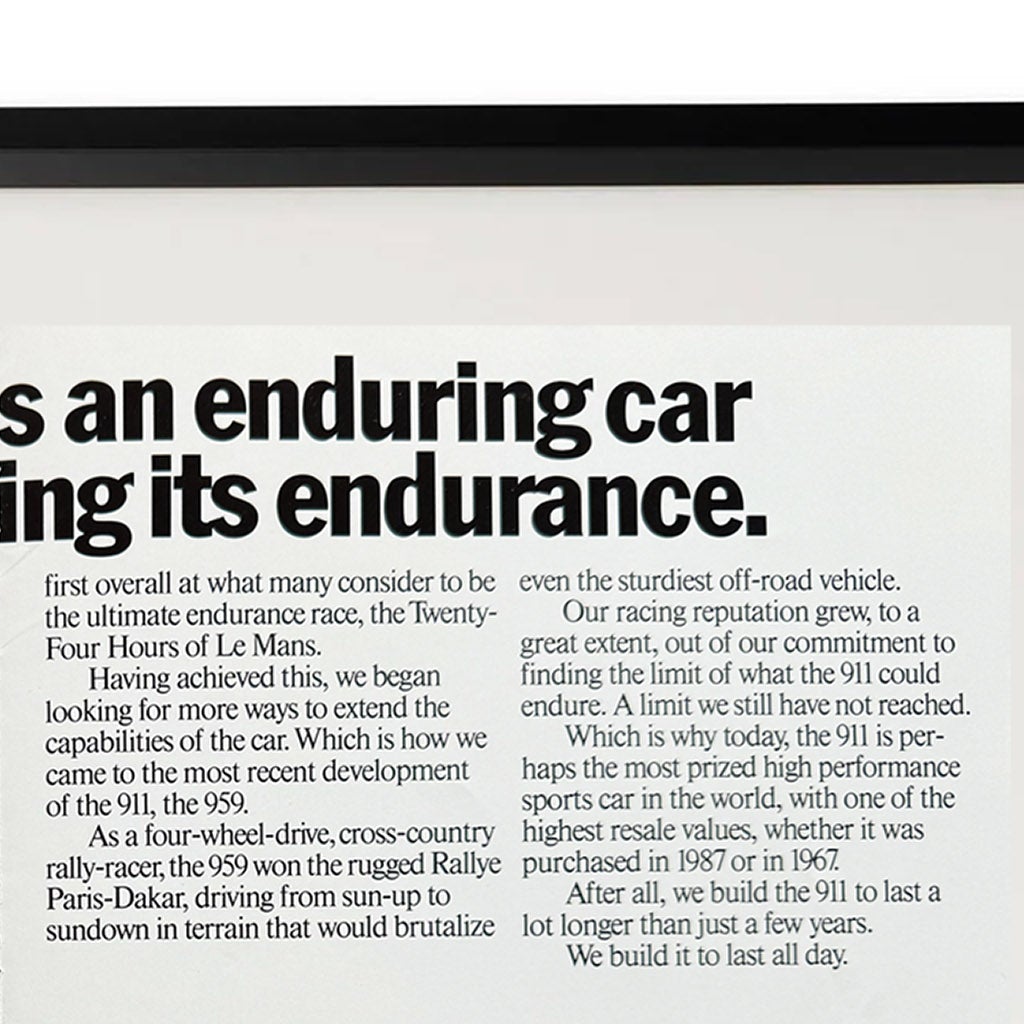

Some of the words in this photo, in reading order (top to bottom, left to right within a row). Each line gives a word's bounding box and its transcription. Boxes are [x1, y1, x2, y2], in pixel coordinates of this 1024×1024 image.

[65, 380, 173, 442] an
[195, 356, 593, 459] enduring
[607, 382, 752, 443] car
[152, 455, 258, 537] its
[277, 452, 766, 537] endurance.
[519, 575, 570, 592] even
[577, 568, 613, 591] the
[618, 568, 714, 592] sturdiest
[719, 567, 813, 592] off-road
[819, 568, 900, 591] vehicle.
[46, 636, 101, 660] Four
[108, 634, 179, 659] Hours
[185, 633, 210, 658] of
[216, 633, 246, 657] Le
[252, 633, 321, 657] Mans.
[521, 662, 603, 690] finding
[609, 661, 645, 685] the
[650, 661, 703, 685] limit
[709, 661, 733, 685] of
[738, 661, 794, 685] what
[800, 661, 836, 684] the
[840, 661, 872, 684] 911
[878, 661, 940, 685] could
[45, 767, 107, 786] came
[112, 764, 135, 785] to
[142, 760, 178, 784] the
[183, 762, 241, 784] most
[247, 762, 317, 783] recent
[322, 758, 470, 786] development
[522, 757, 577, 784] haps
[583, 755, 619, 779] the
[624, 758, 682, 779] most
[687, 755, 757, 783] prized
[764, 755, 812, 783] high
[818, 754, 961, 783] performance
[522, 818, 604, 847] highest
[610, 817, 676, 841] resale
[682, 817, 757, 845] values,
[764, 817, 855, 840] whether
[860, 817, 876, 840] it
[881, 823, 924, 840] was
[47, 886, 189, 913] Paris-Dakar,
[195, 885, 275, 913] driving
[280, 884, 336, 908] from
[342, 889, 421, 912] sun-up
[427, 886, 451, 906] to
